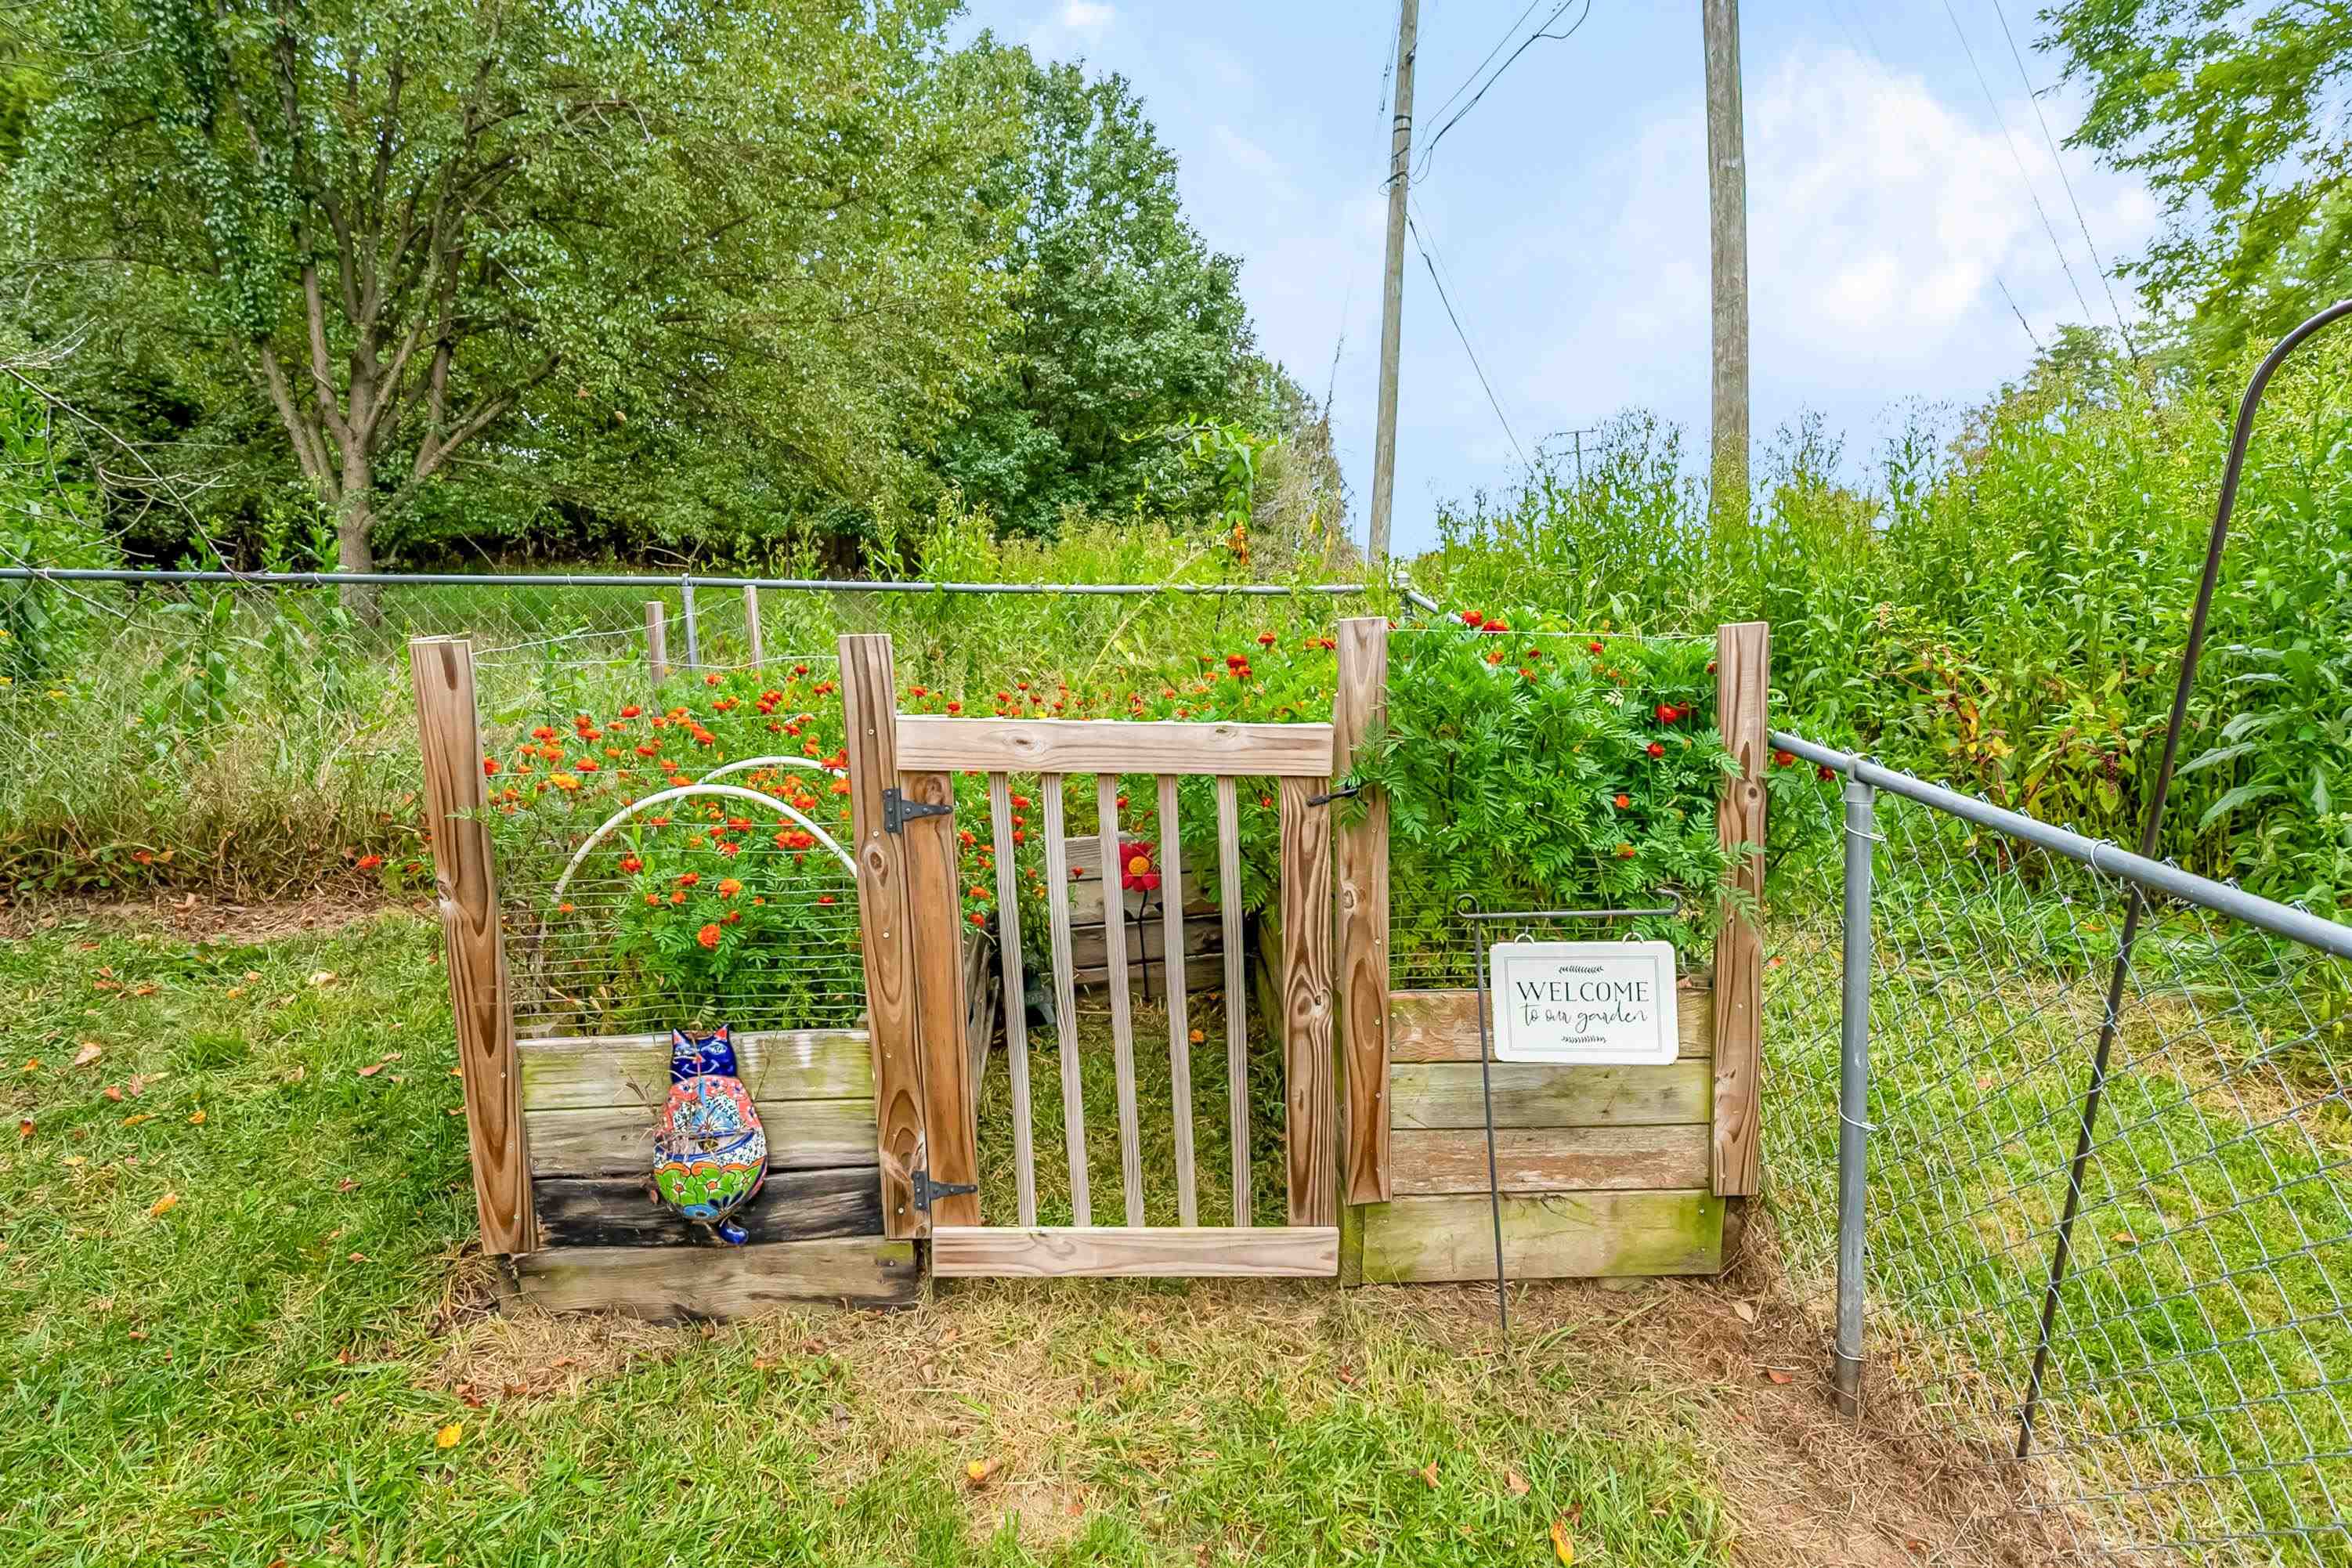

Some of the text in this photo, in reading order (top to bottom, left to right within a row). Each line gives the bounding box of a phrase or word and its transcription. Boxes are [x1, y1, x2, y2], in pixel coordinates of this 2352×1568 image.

[1516, 981, 1649, 1002] WELCOME
[1519, 1000, 1648, 1034] to our garden
